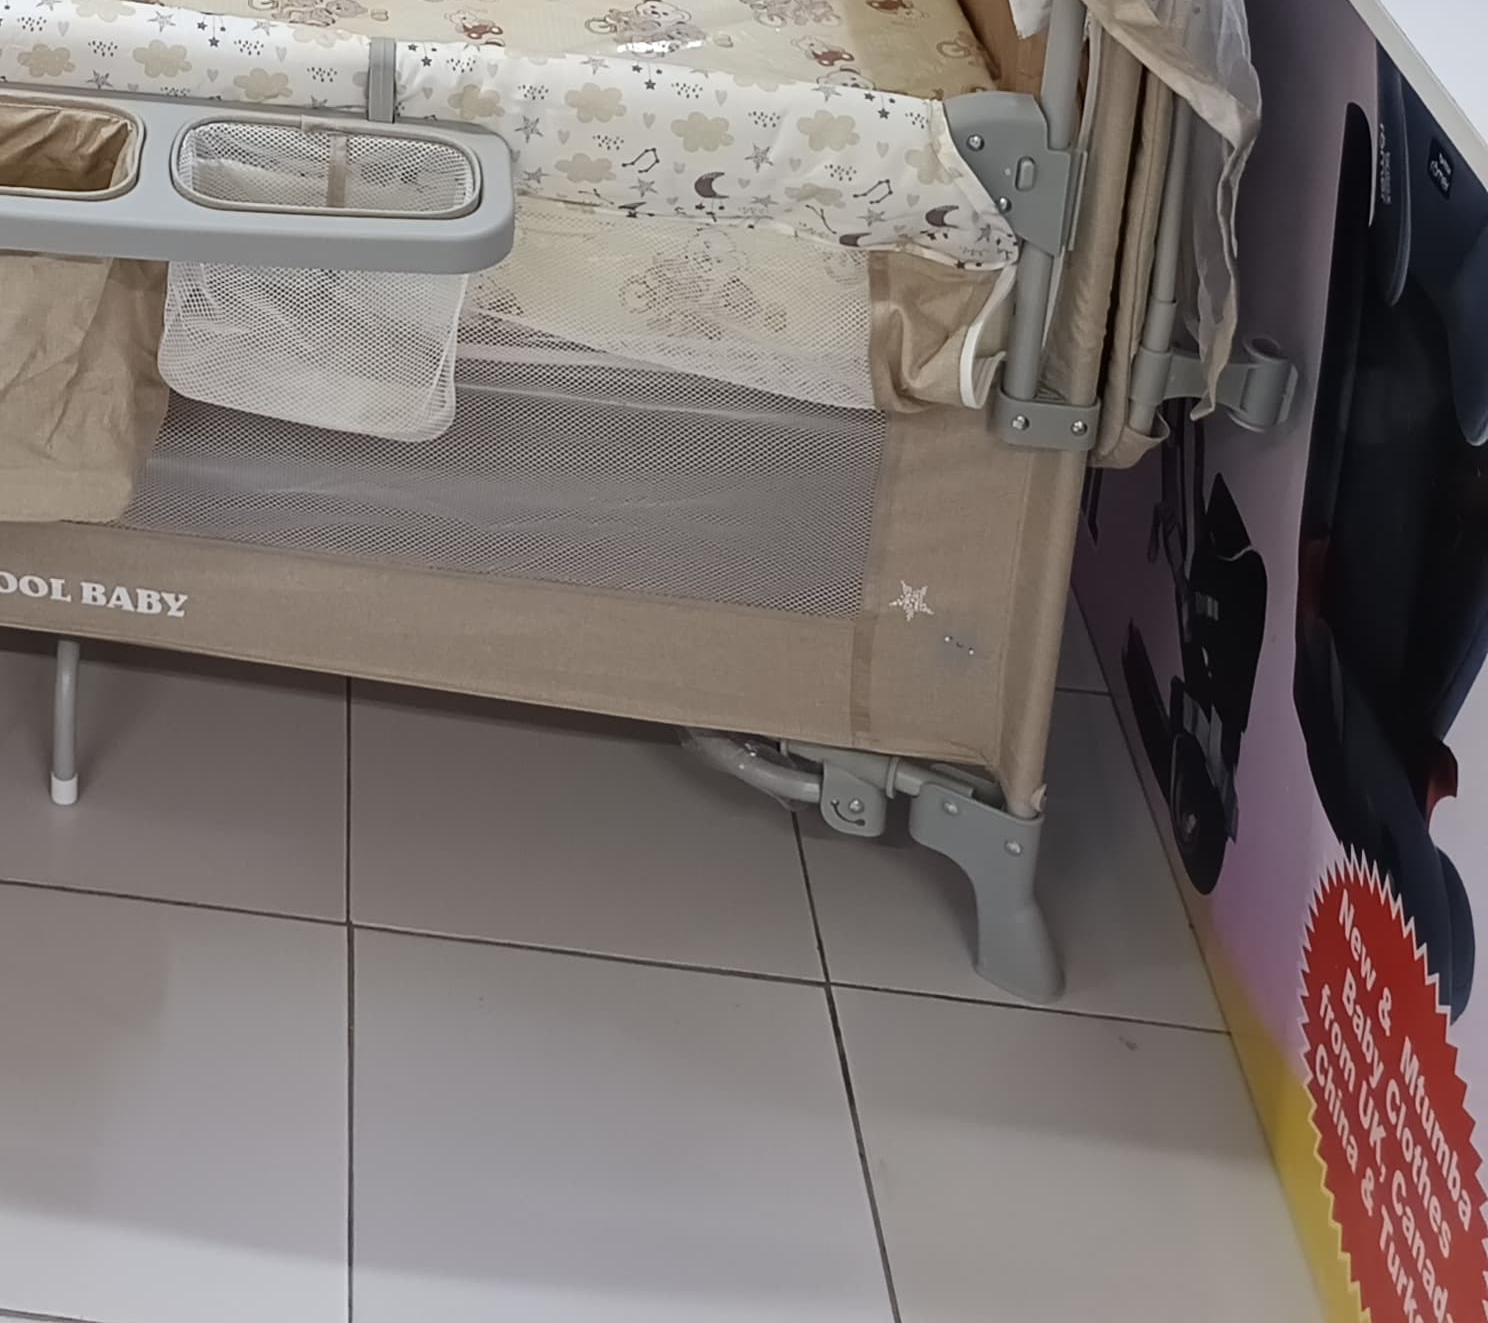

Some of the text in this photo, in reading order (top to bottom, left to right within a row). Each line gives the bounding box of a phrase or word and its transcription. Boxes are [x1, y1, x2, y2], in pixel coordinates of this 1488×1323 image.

[81, 582, 188, 617] BABY
[1316, 1044, 1358, 1174] China
[1362, 1168, 1374, 1216] &
[1320, 984, 1454, 1323] from UK, Canad
[1339, 889, 1471, 1232] New & Mtumba
[1342, 968, 1451, 1258] Baby Clothes
